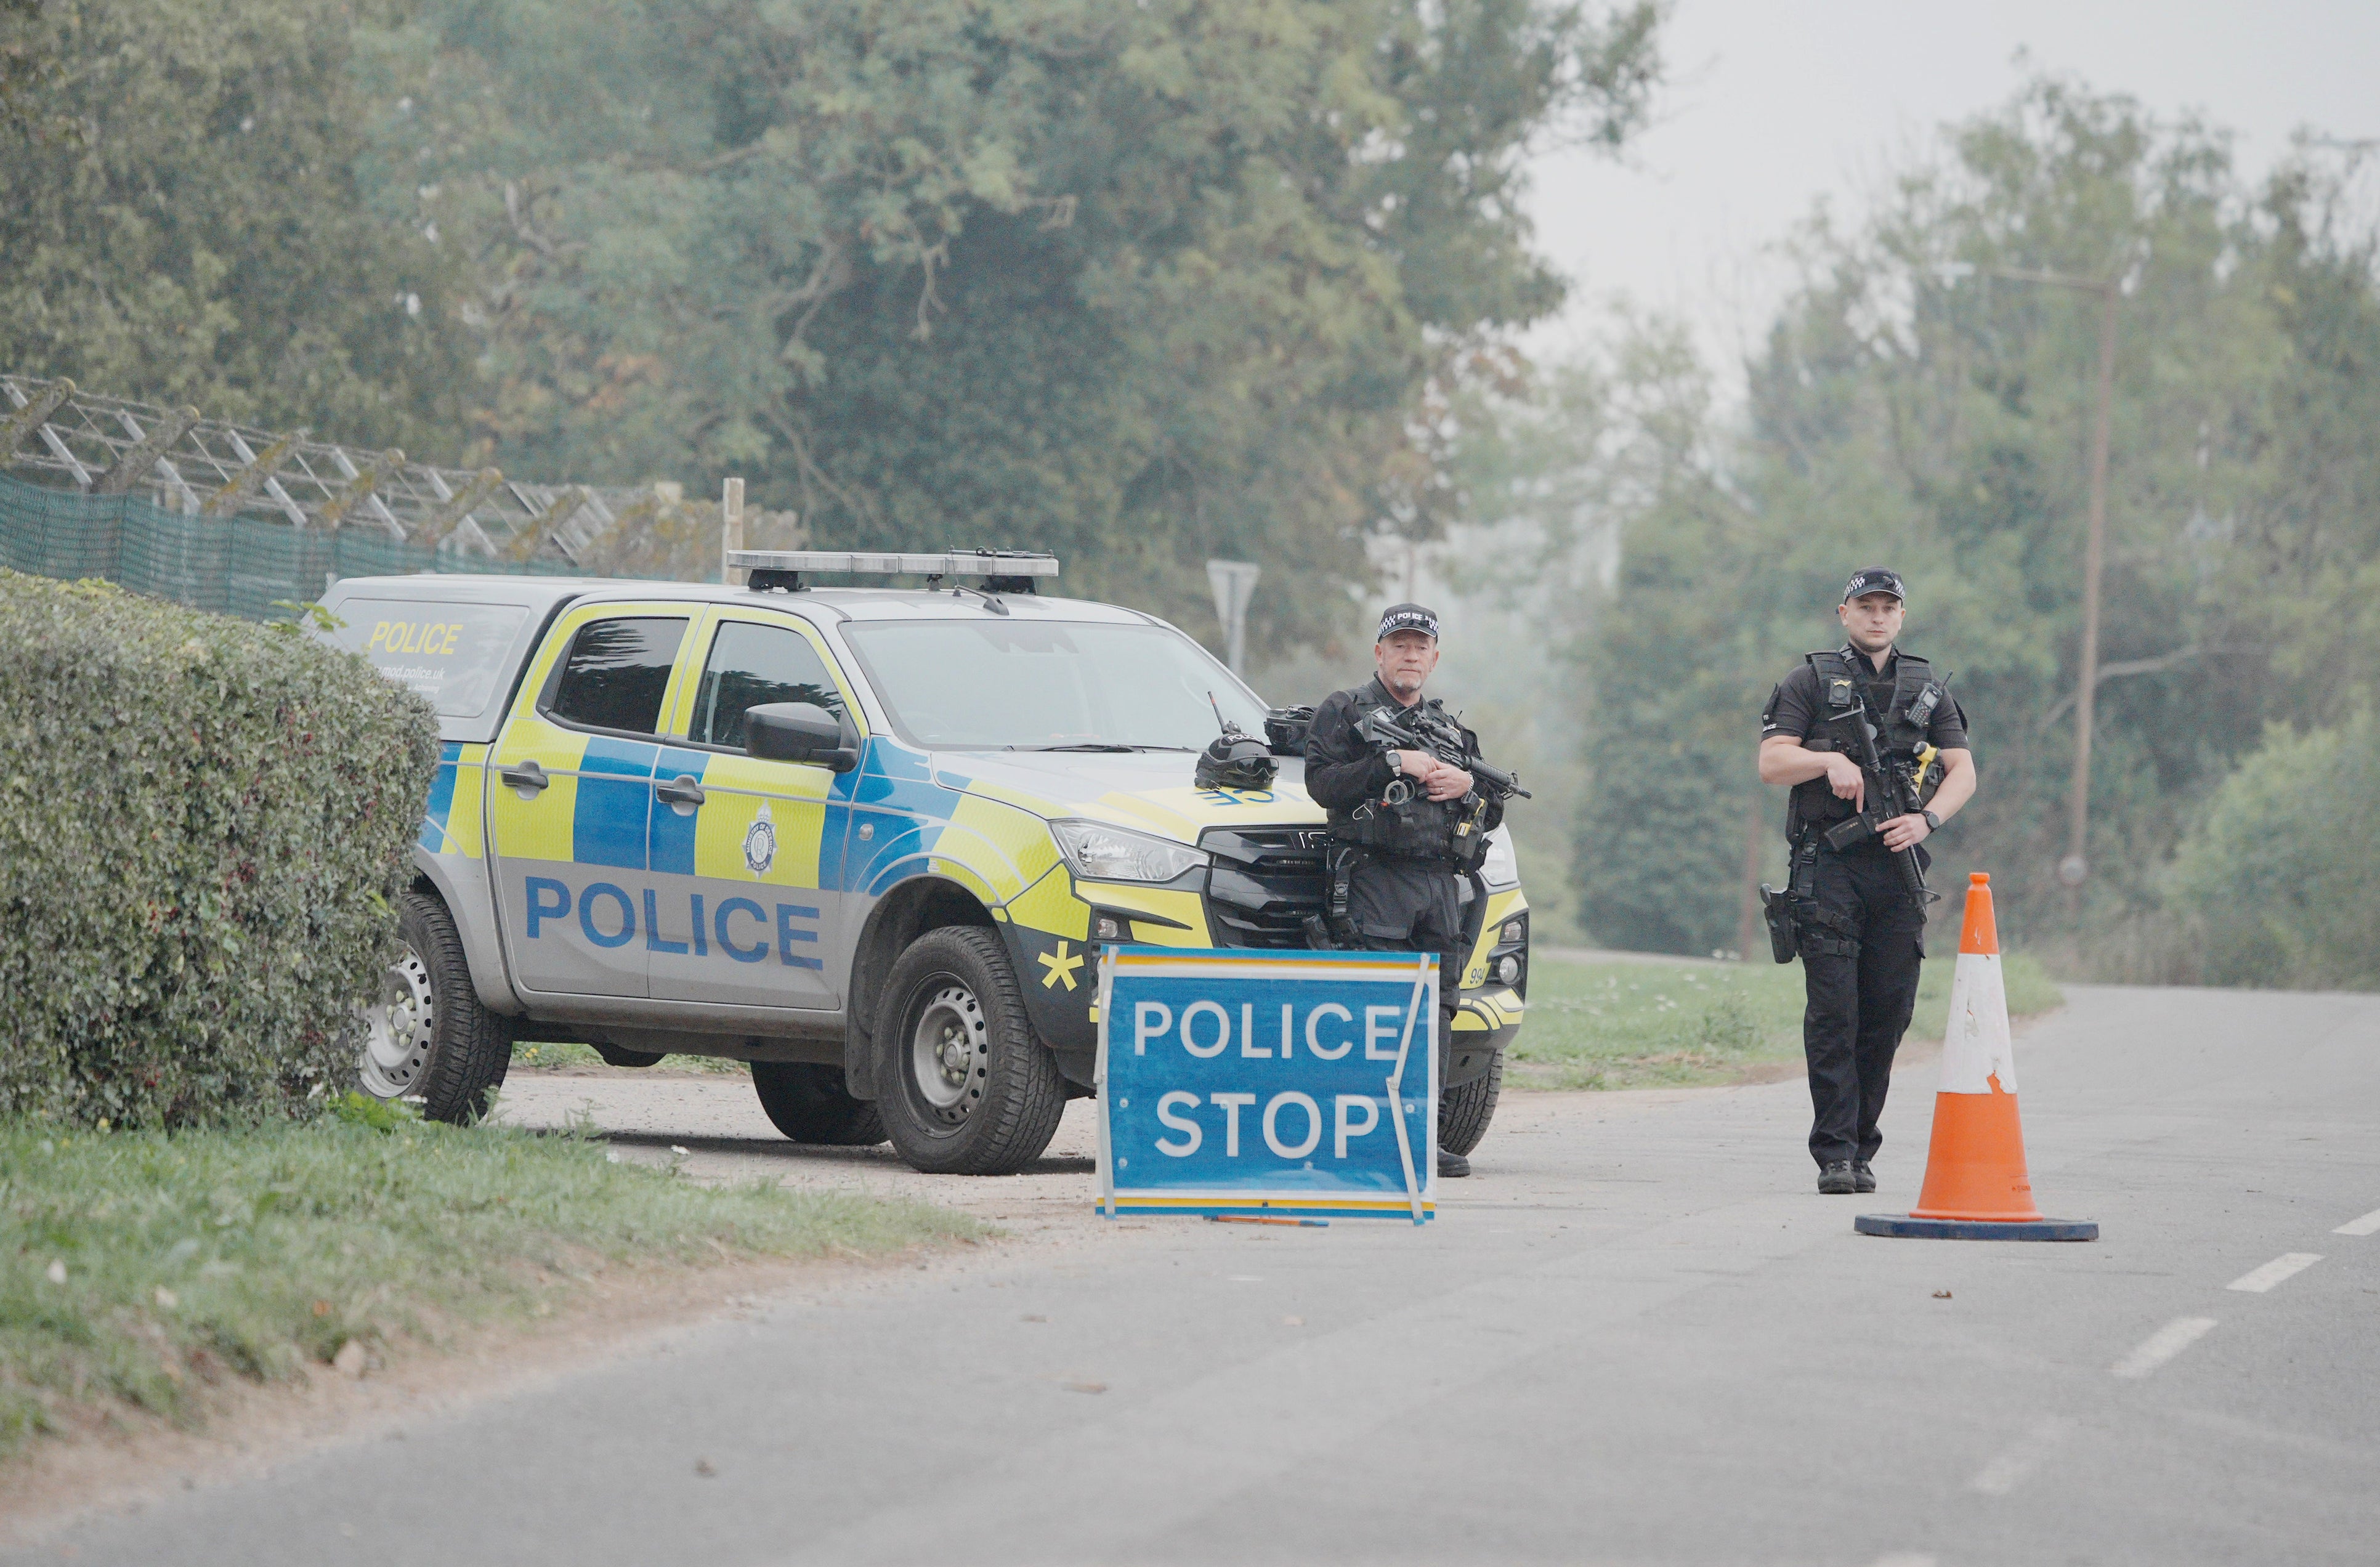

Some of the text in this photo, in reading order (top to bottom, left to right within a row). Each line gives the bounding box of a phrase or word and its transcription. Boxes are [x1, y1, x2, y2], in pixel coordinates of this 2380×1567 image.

[370, 621, 463, 655] POLICE
[746, 825, 759, 853] MINISTRY
[764, 826, 774, 856] DEFENCE
[750, 860, 767, 870] POLICE
[525, 876, 824, 971] POLICE
[1134, 1000, 1401, 1061] POLICE
[1154, 1090, 1380, 1160] STOP
